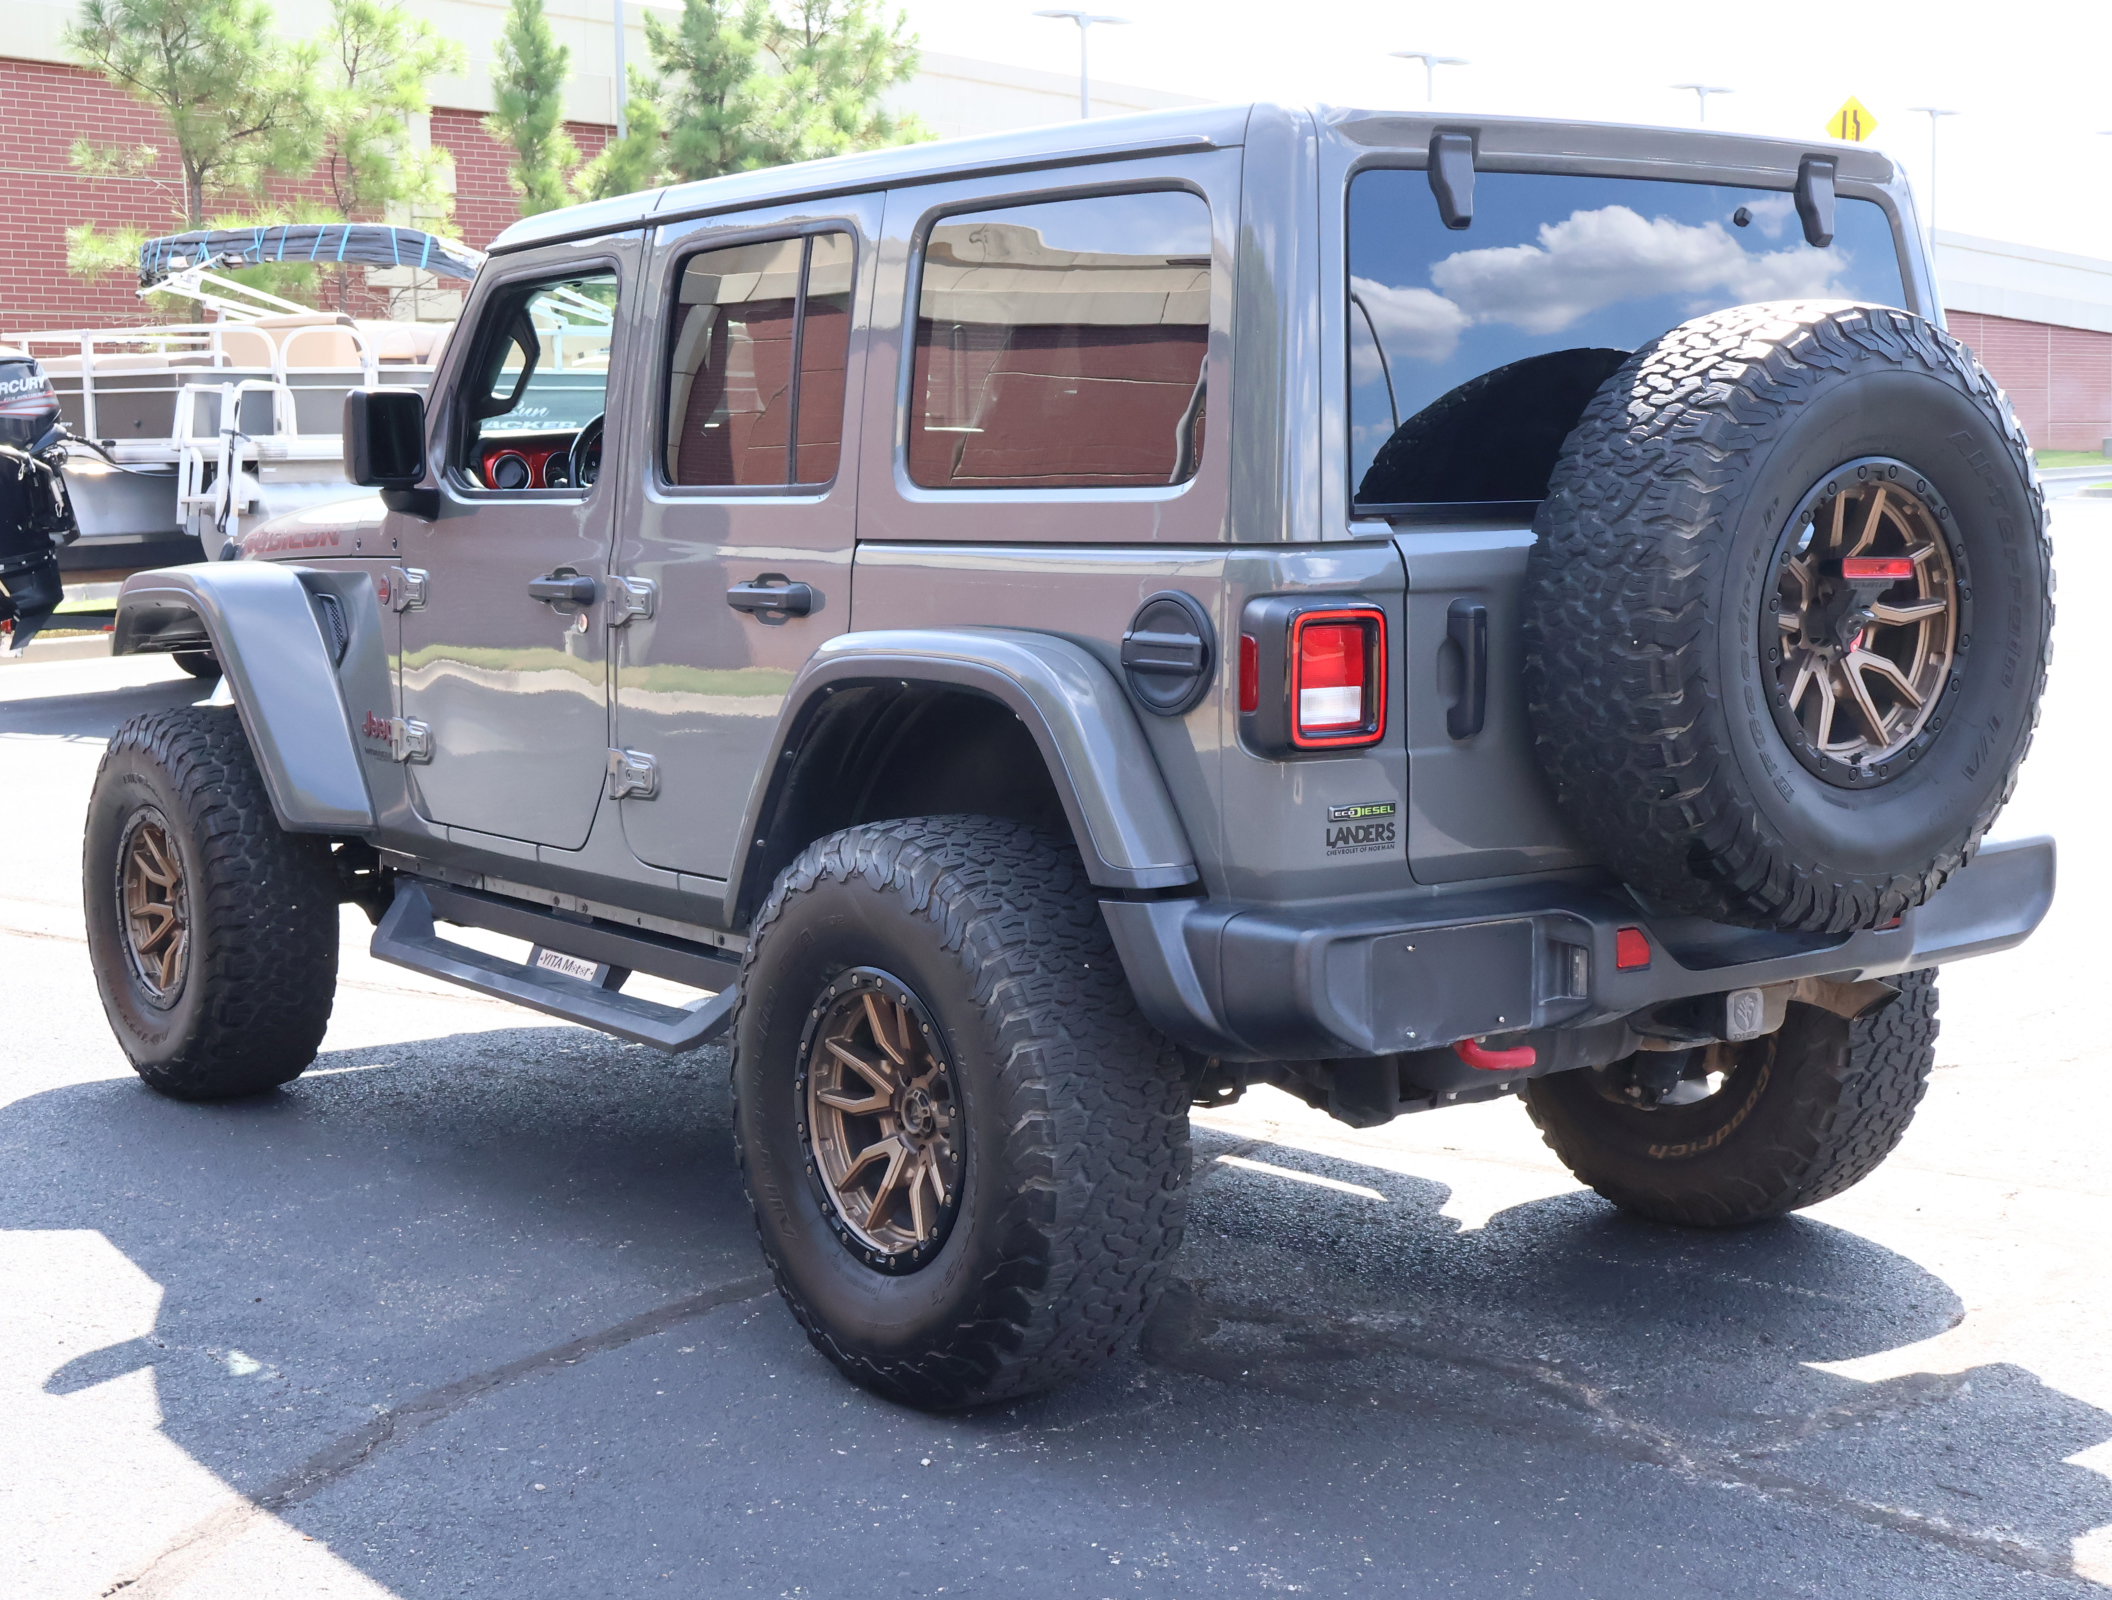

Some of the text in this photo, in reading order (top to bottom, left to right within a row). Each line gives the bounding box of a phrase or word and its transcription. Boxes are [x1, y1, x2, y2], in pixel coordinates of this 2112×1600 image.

[0, 375, 47, 395] RCURY
[481, 420, 577, 430] ACKER
[1326, 822, 1395, 849] LANDERS
[1326, 848, 1358, 856] CHEVROLET
[1368, 844, 1395, 852] NORMAN
